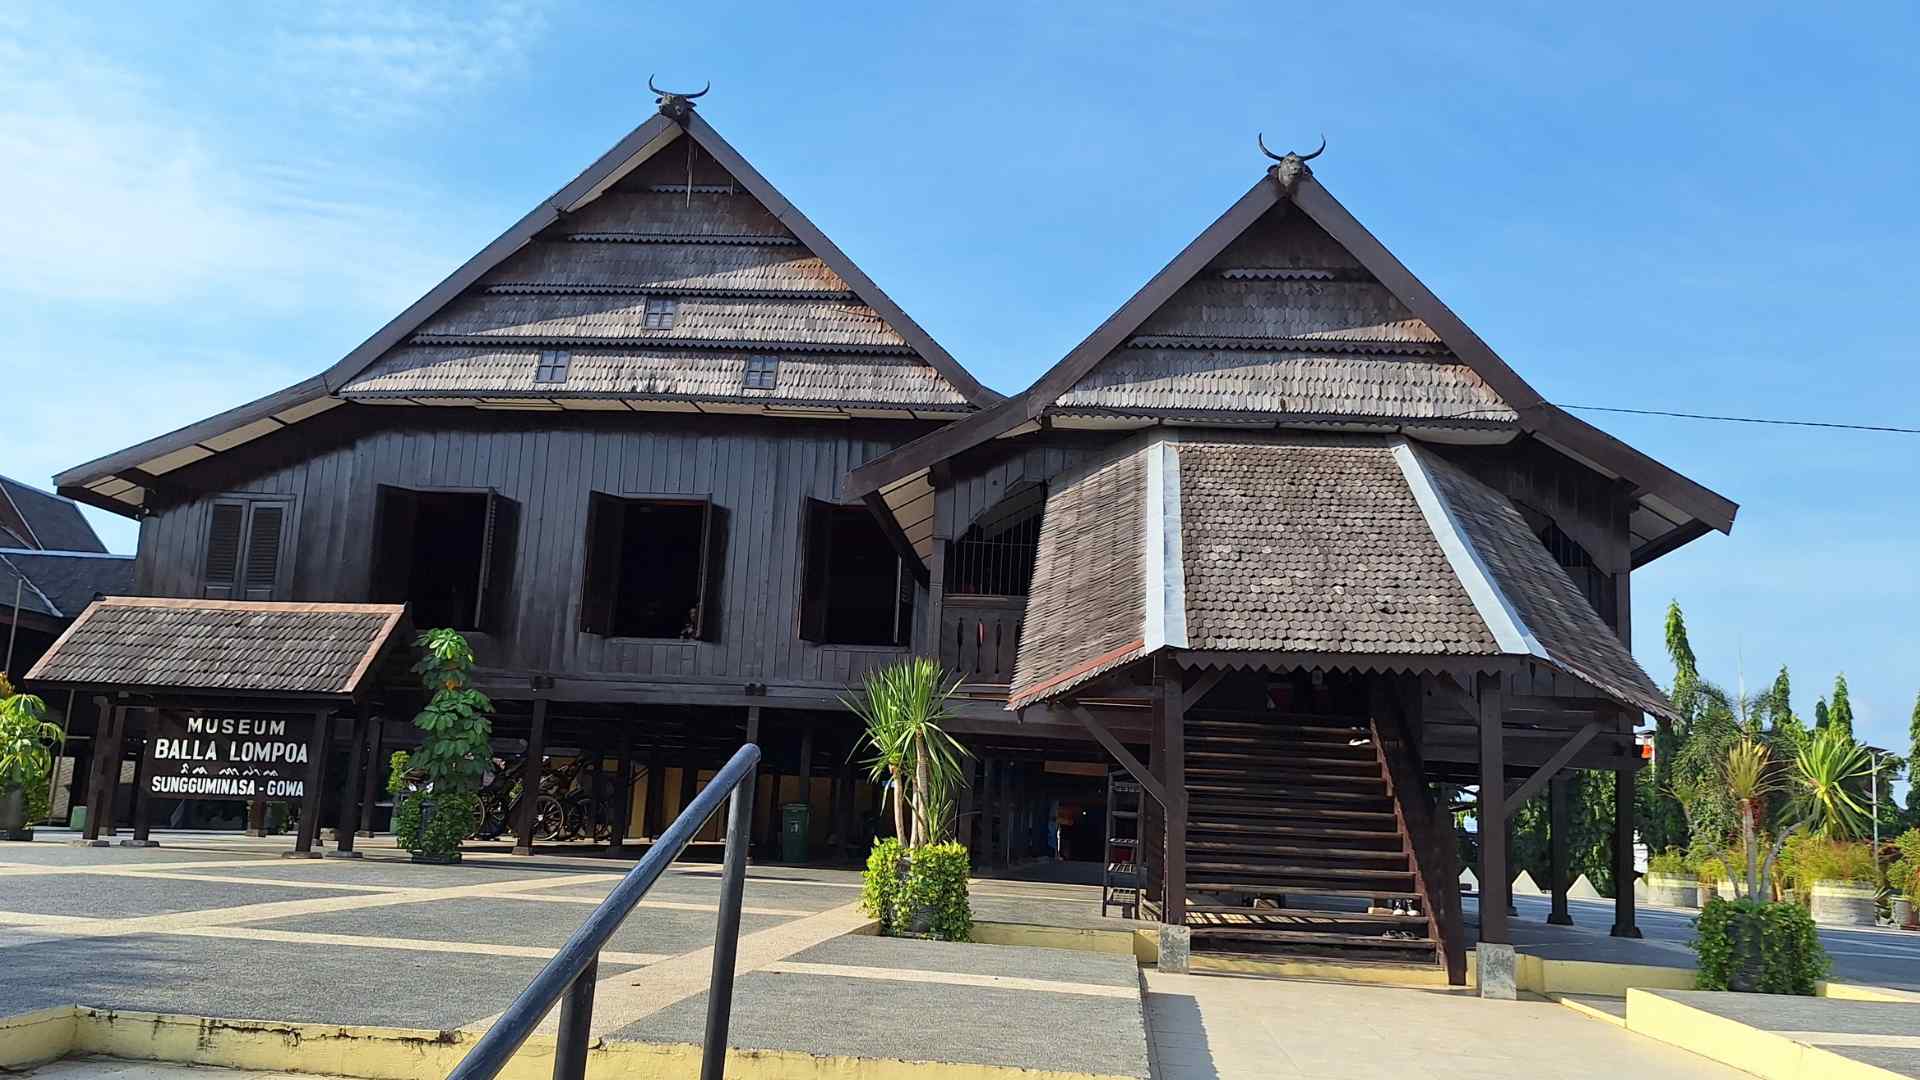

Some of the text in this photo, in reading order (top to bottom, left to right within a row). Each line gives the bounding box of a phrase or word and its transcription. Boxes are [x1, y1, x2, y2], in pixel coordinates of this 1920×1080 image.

[187, 717, 285, 736] MUSEUM
[154, 738, 308, 763] BALLA LOMPOA
[151, 775, 256, 796] SUNGGUMINASA
[266, 780, 304, 797] GOWA
